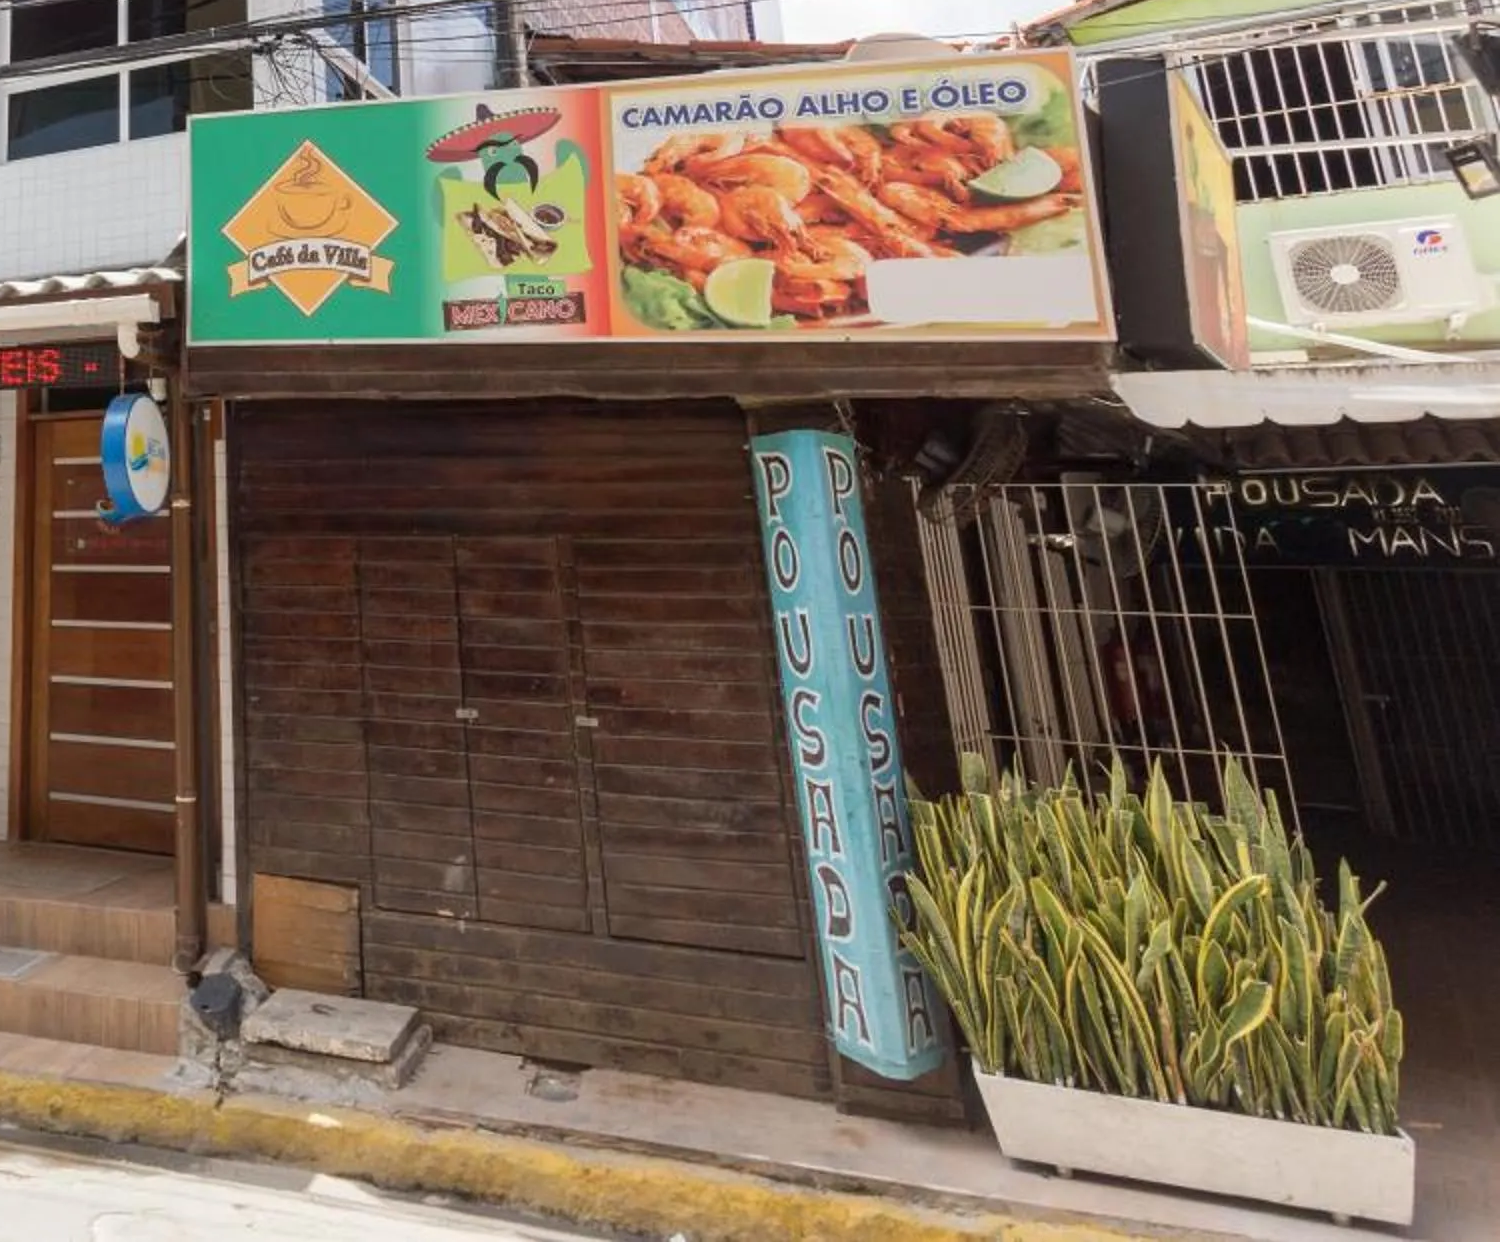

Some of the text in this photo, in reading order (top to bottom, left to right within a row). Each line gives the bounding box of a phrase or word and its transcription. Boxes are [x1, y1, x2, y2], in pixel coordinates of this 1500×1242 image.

[622, 79, 1027, 129] CAMARÃO ALHO E ÓLEO
[251, 245, 295, 271] Café
[297, 243, 320, 264] da
[517, 283, 556, 296] Taco
[1204, 474, 1446, 507] POUSADA
[757, 447, 873, 1053] POUSADA
[824, 445, 936, 1058] POUSADA
